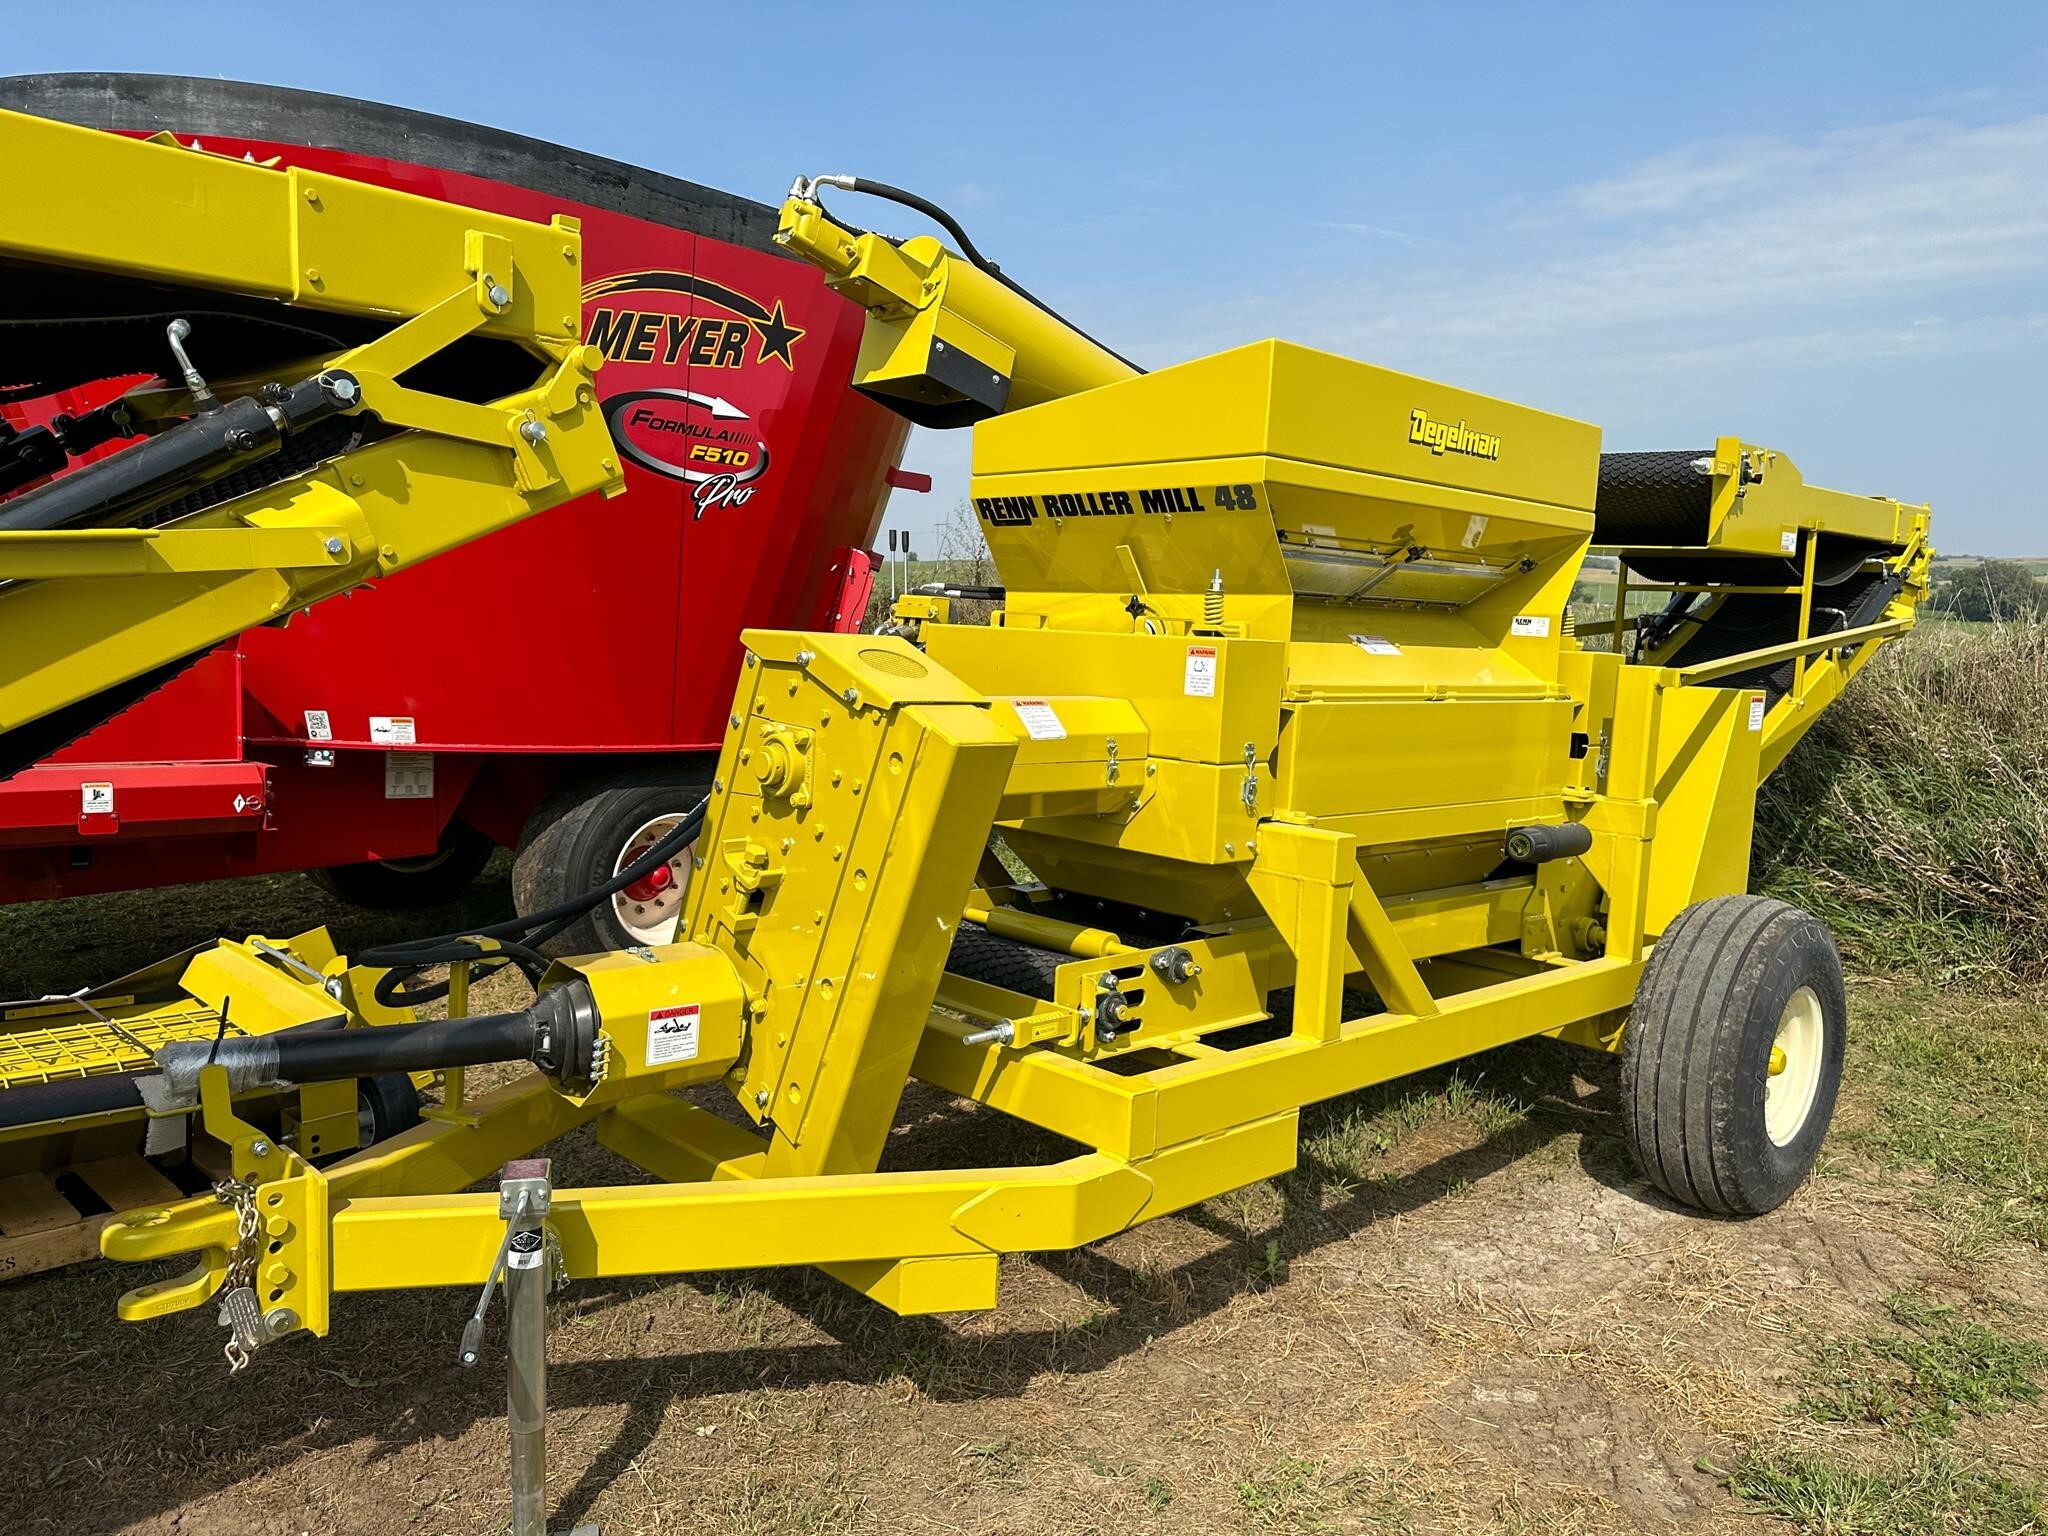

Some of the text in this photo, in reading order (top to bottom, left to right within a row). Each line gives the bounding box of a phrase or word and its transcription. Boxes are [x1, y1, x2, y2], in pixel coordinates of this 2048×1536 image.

[587, 308, 750, 368] MEYER
[689, 444, 750, 467] F510
[1409, 408, 1501, 461] Degelman
[692, 473, 756, 521] Pro
[976, 483, 1257, 527] RENN ROLLER MILL 48
[664, 1007, 694, 1018] DANGER
